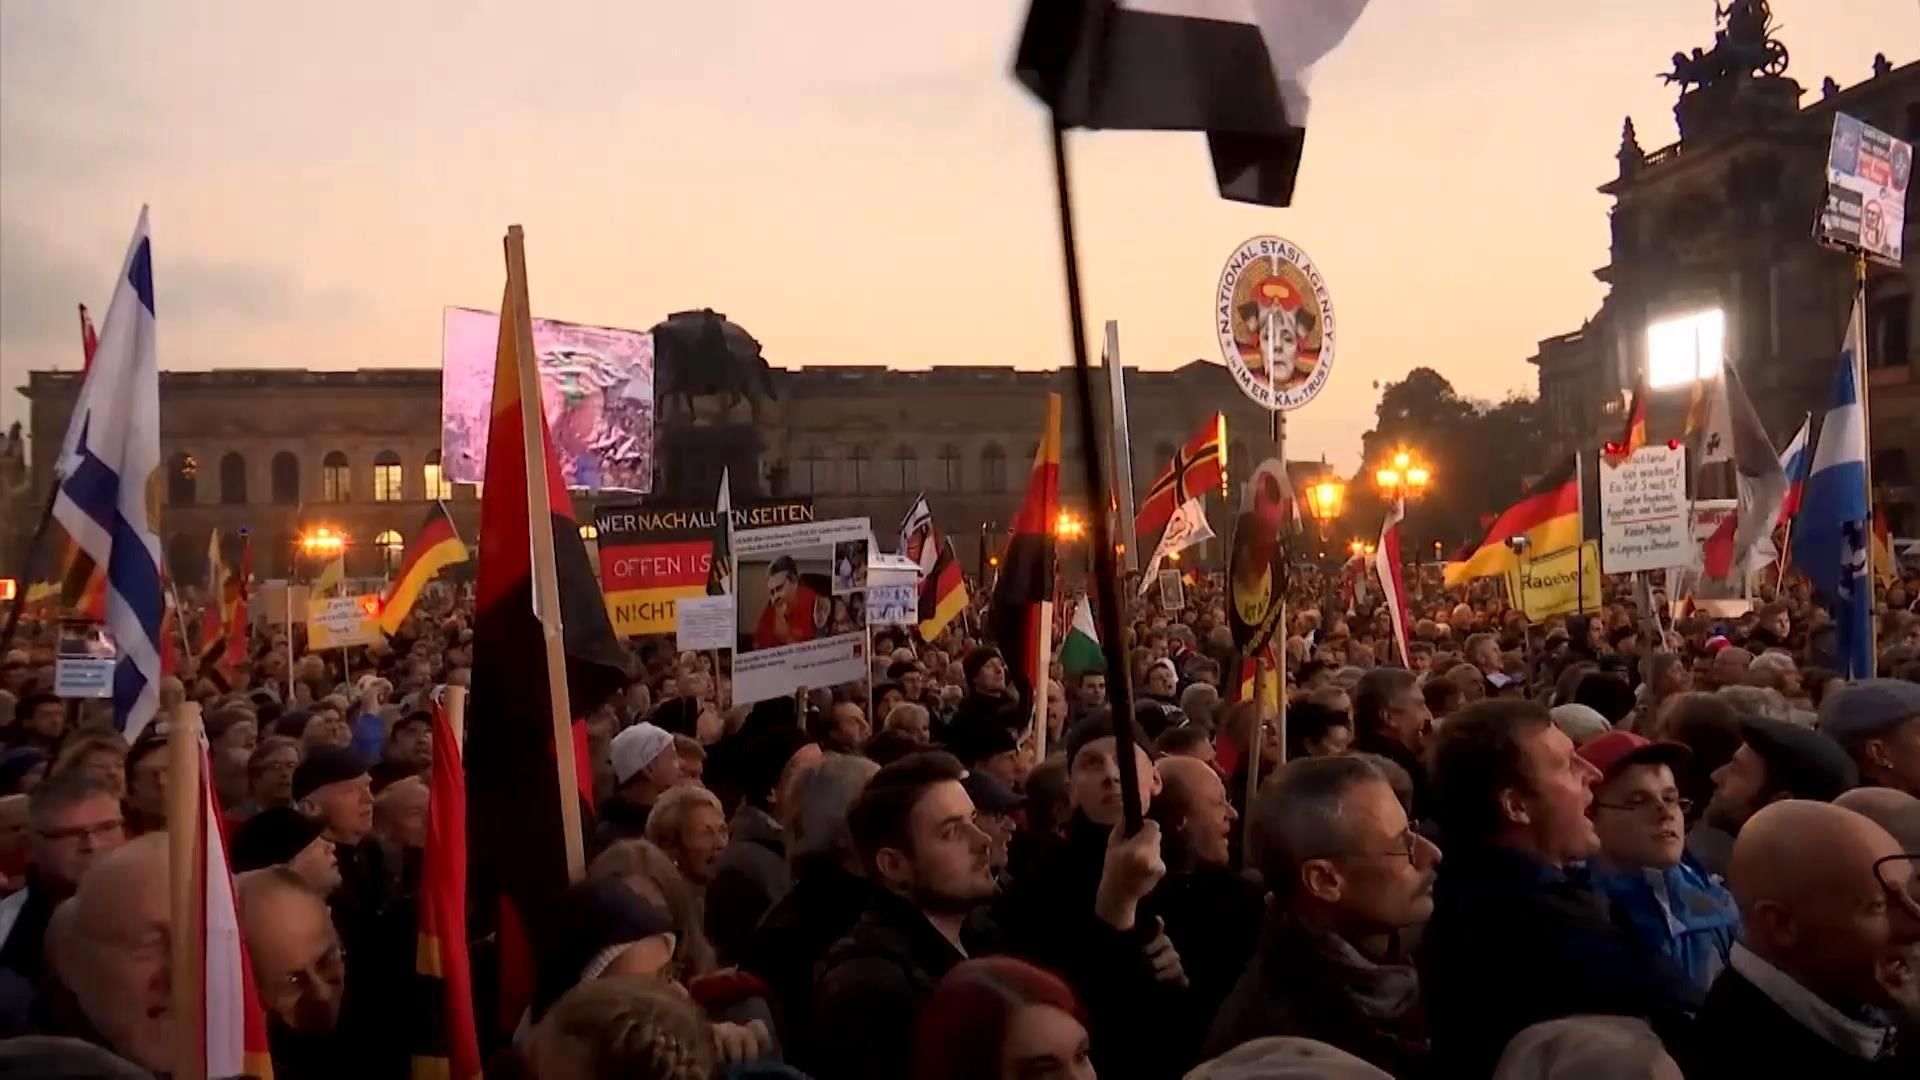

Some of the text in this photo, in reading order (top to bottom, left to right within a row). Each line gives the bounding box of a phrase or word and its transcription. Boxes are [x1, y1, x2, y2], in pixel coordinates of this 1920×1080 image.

[1220, 240, 1334, 342] NATIONAL STASI AGENCY
[1251, 383, 1293, 406] ERKA
[1303, 362, 1329, 397] TRUST
[750, 504, 815, 524] SEITEN
[614, 556, 681, 578] OFFEN
[616, 600, 676, 623] NICHT
